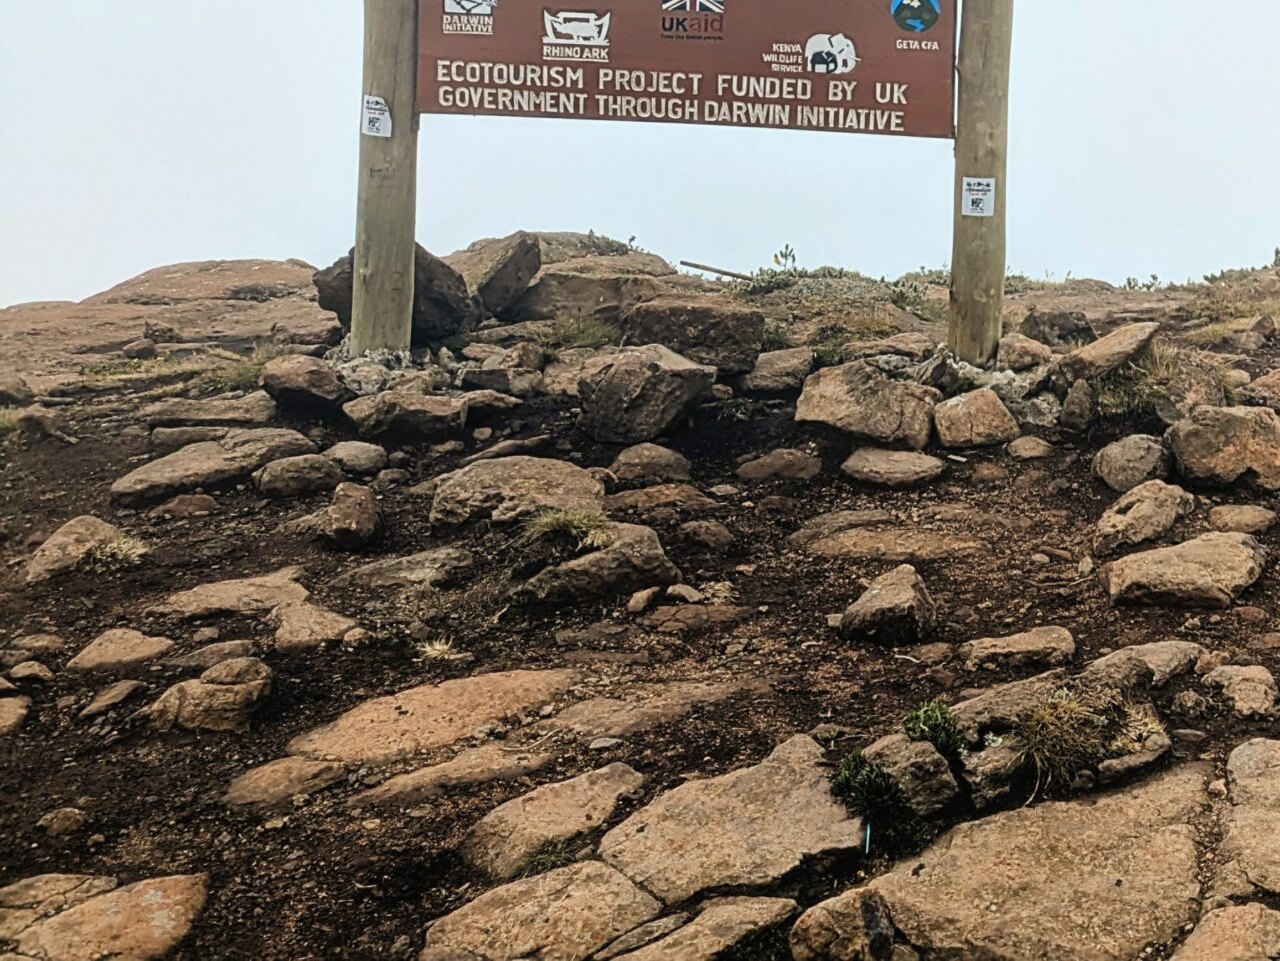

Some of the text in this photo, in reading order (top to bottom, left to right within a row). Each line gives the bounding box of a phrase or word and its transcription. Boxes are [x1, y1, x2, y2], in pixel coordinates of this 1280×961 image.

[443, 15, 493, 25] DARWIN
[443, 23, 493, 32] INITIATIVE
[773, 43, 802, 53] KENYA
[896, 39, 939, 51] GETA CFA
[543, 45, 608, 59] RHINO ARK
[762, 53, 803, 64] WILDLIFE
[771, 64, 803, 73] SERVICE
[437, 60, 908, 105] ECOTOURISM PROJECT FUNDED BY UK
[438, 86, 905, 132] GOVERNMENT THROUGH DARWIN INITIATIVE
